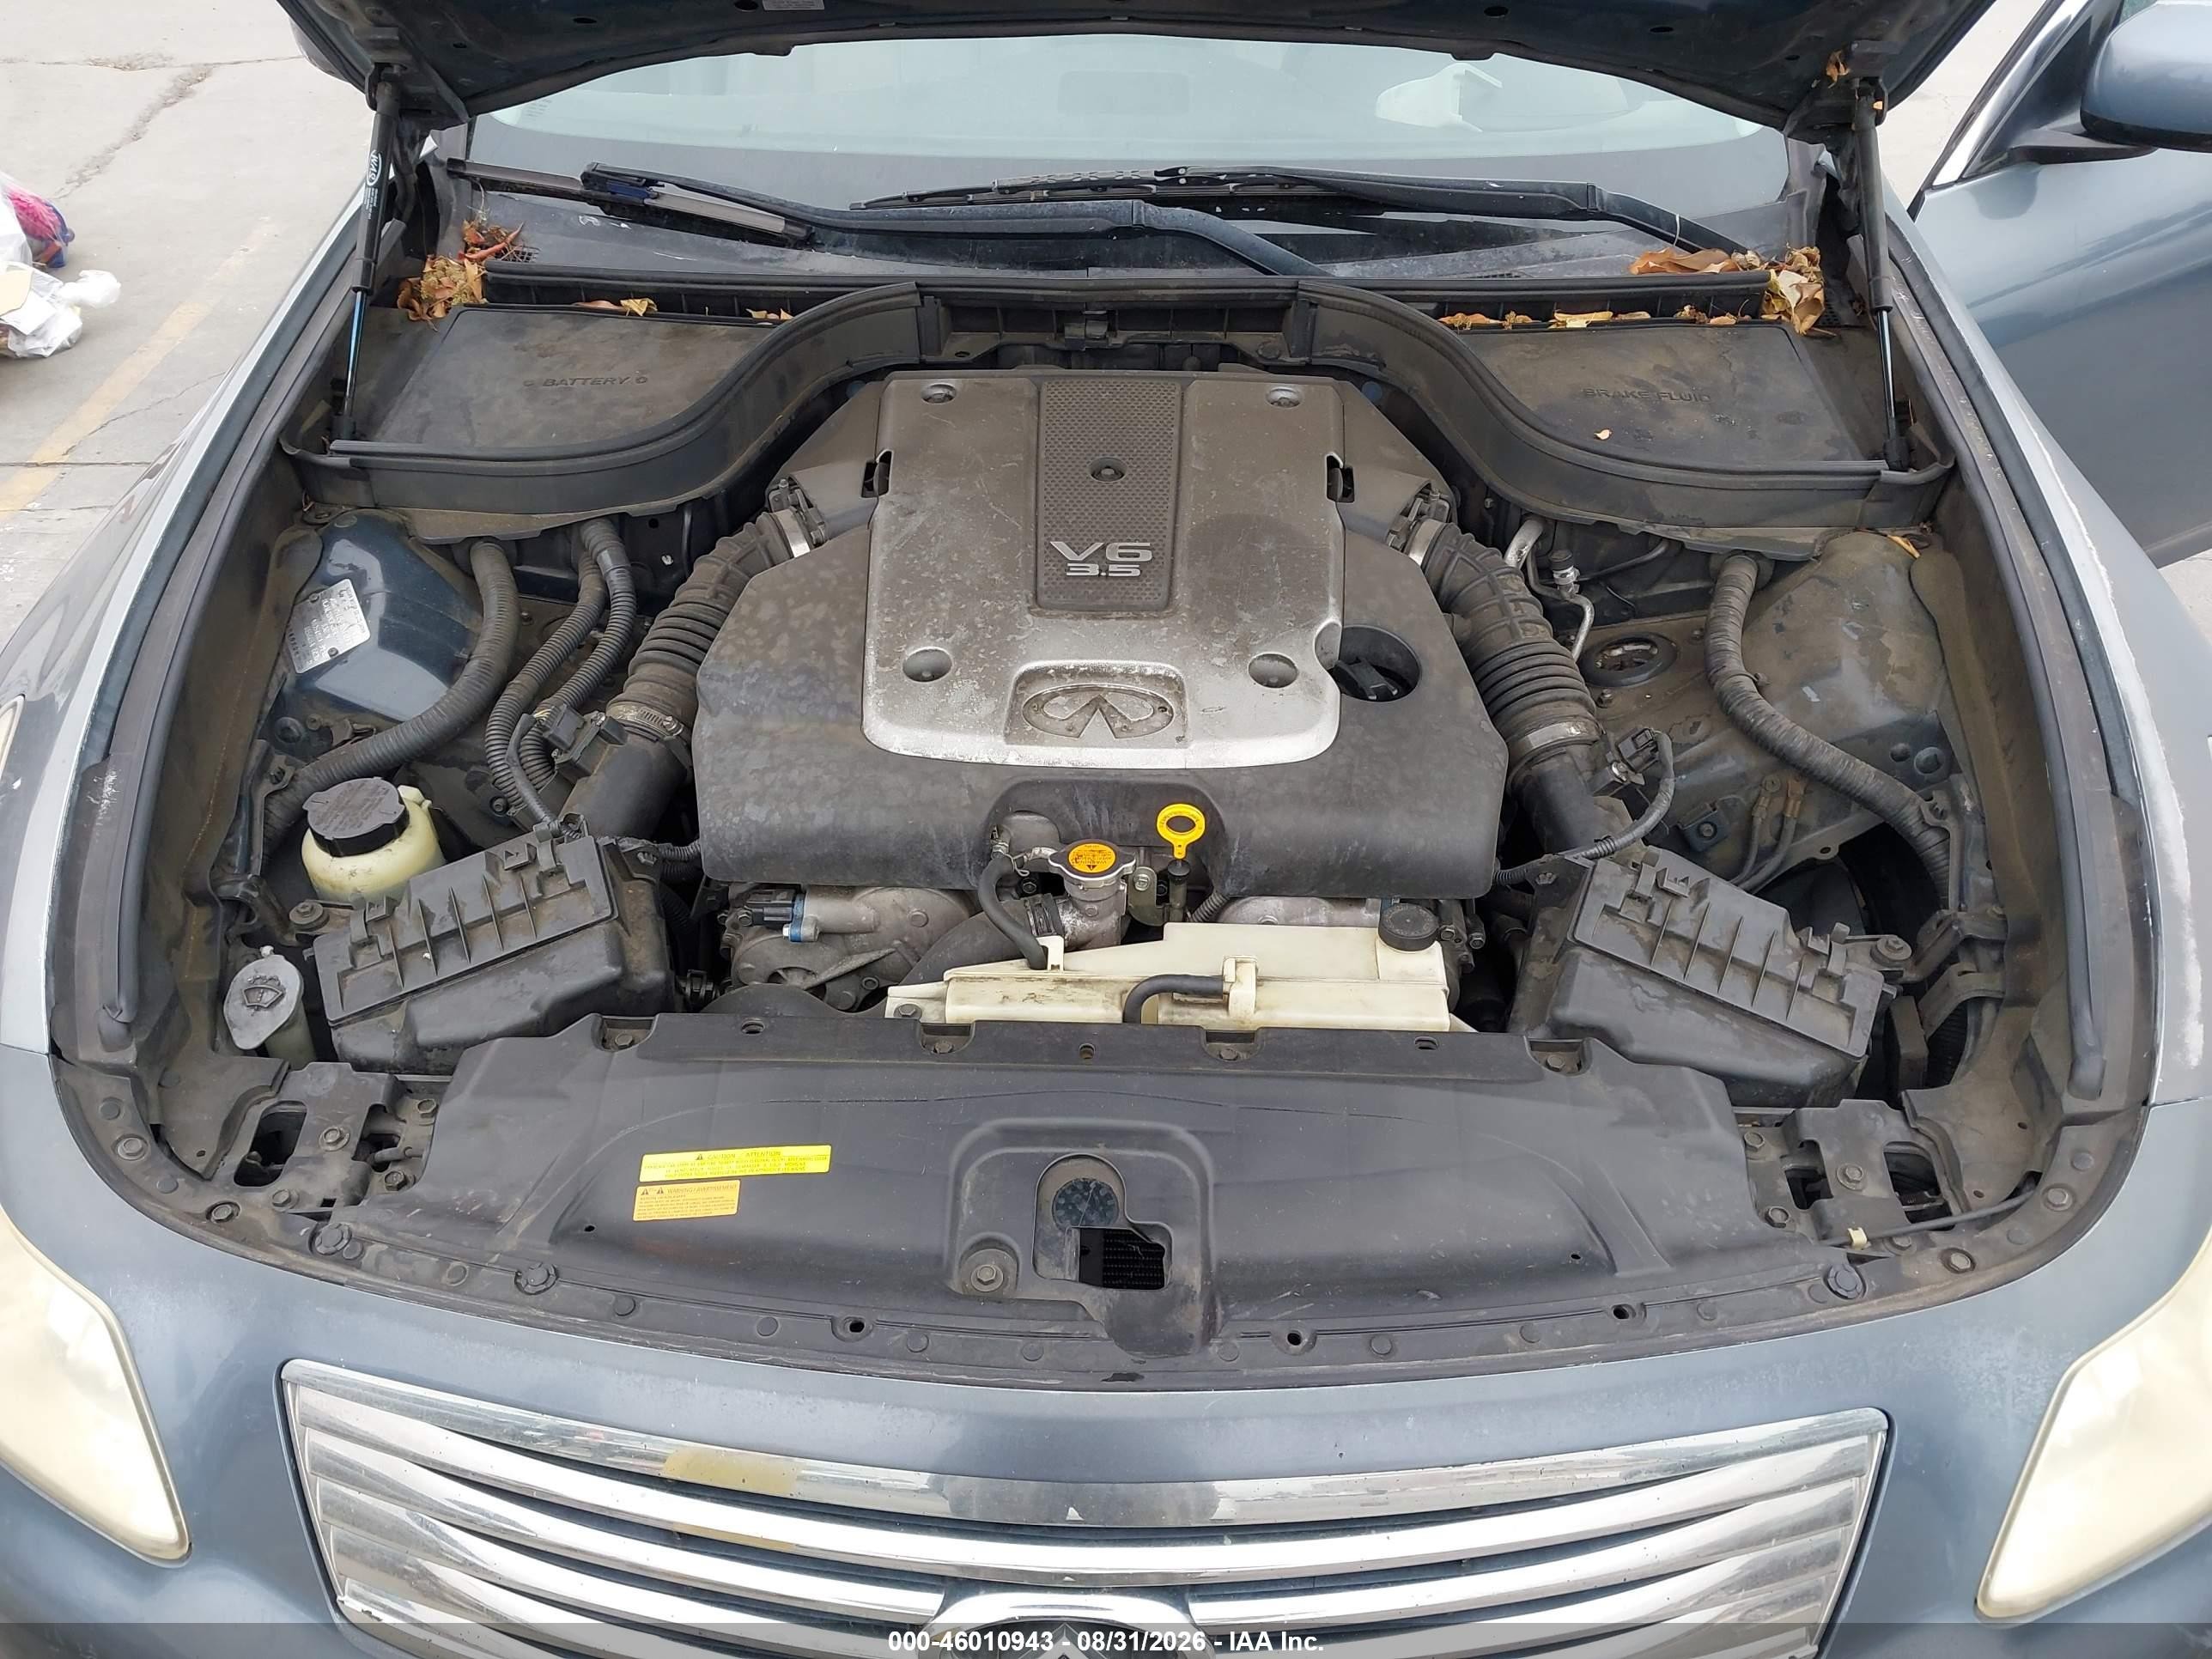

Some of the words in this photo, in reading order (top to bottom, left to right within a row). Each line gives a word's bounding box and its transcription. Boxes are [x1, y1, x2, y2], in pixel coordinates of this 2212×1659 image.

[542, 377, 631, 386] BATTERY
[1582, 388, 1650, 398] BRAKE
[1656, 392, 1711, 402] FLUID
[1050, 541, 1152, 562] V6
[1066, 562, 1141, 577] 3.5
